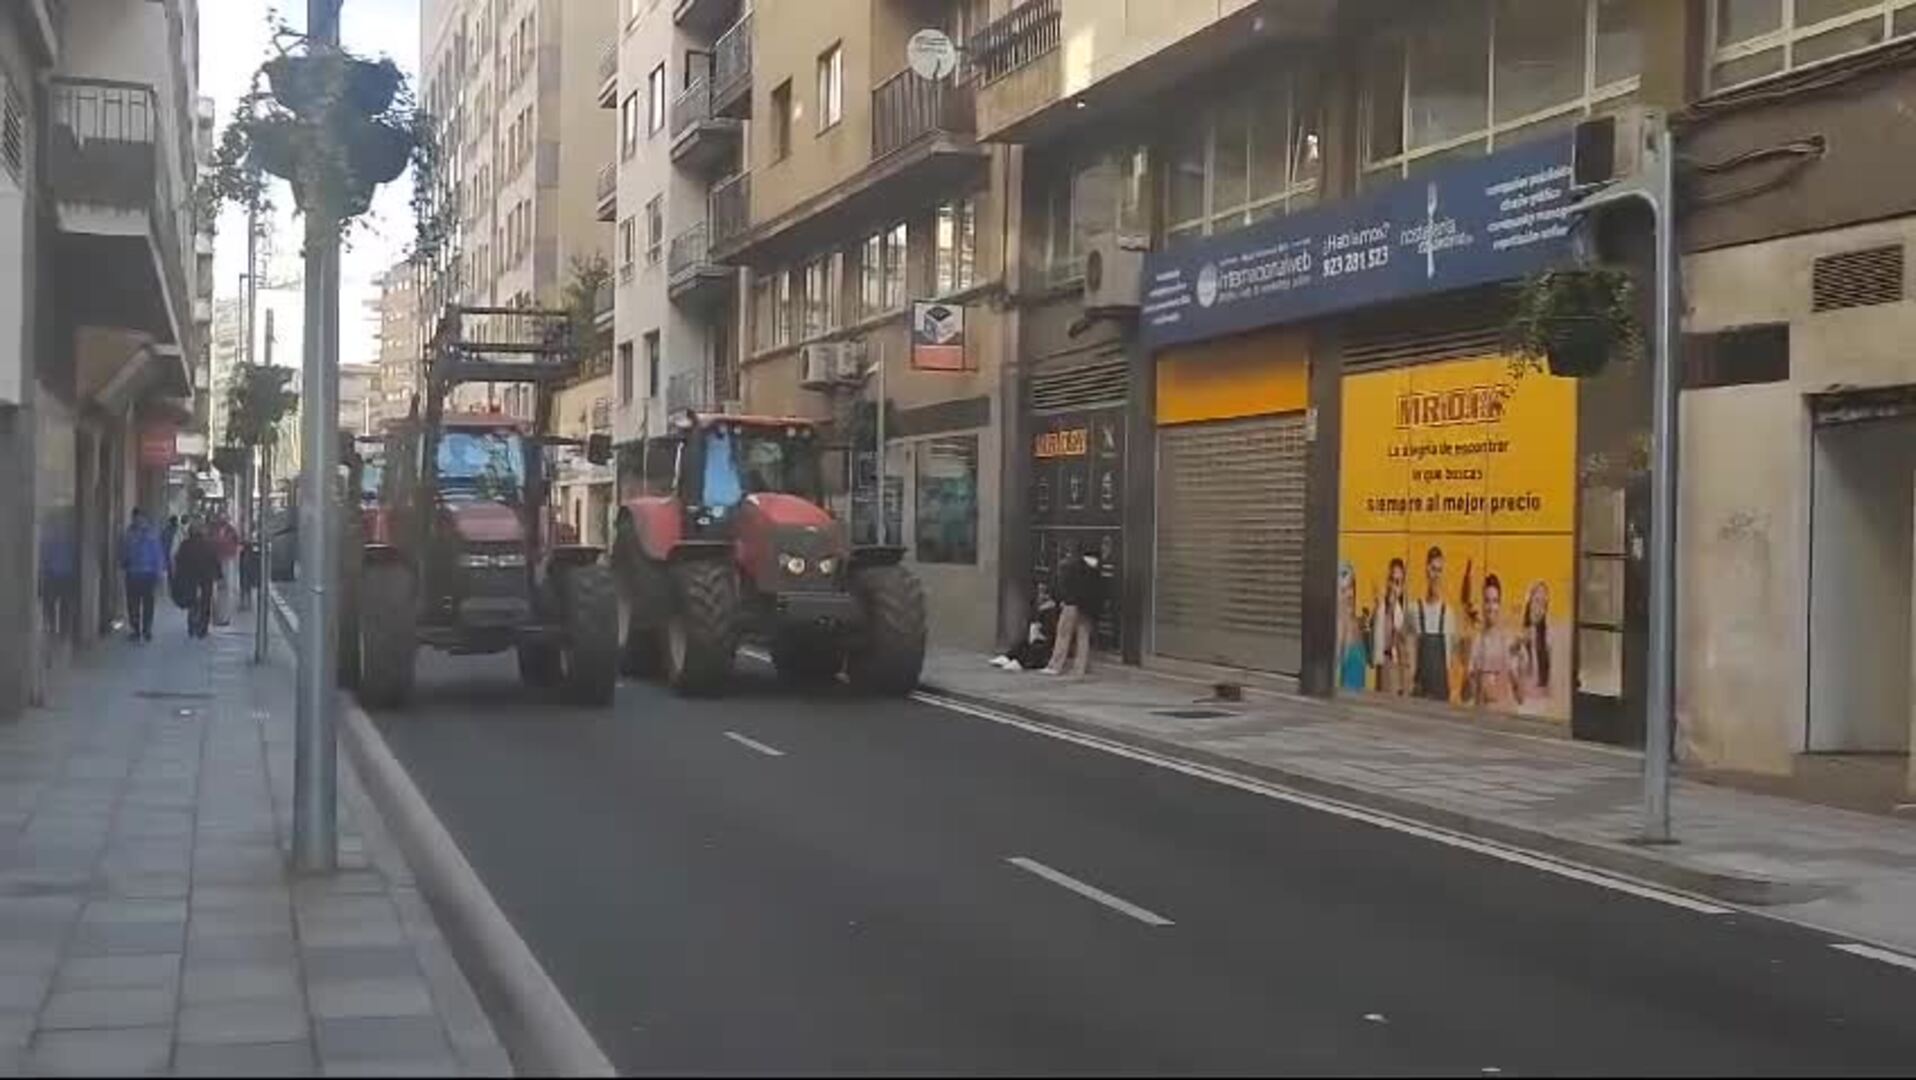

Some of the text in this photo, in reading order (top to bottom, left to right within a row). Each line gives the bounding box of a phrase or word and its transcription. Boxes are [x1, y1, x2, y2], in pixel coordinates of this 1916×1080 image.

[1322, 254, 1343, 277] 923
[1368, 246, 1389, 268] 523
[1440, 440, 1453, 456] de
[1455, 440, 1509, 455] encontrar
[1423, 469, 1442, 484] que
[1445, 467, 1483, 481] buscas
[1367, 492, 1542, 515] siempre al mejor precio
